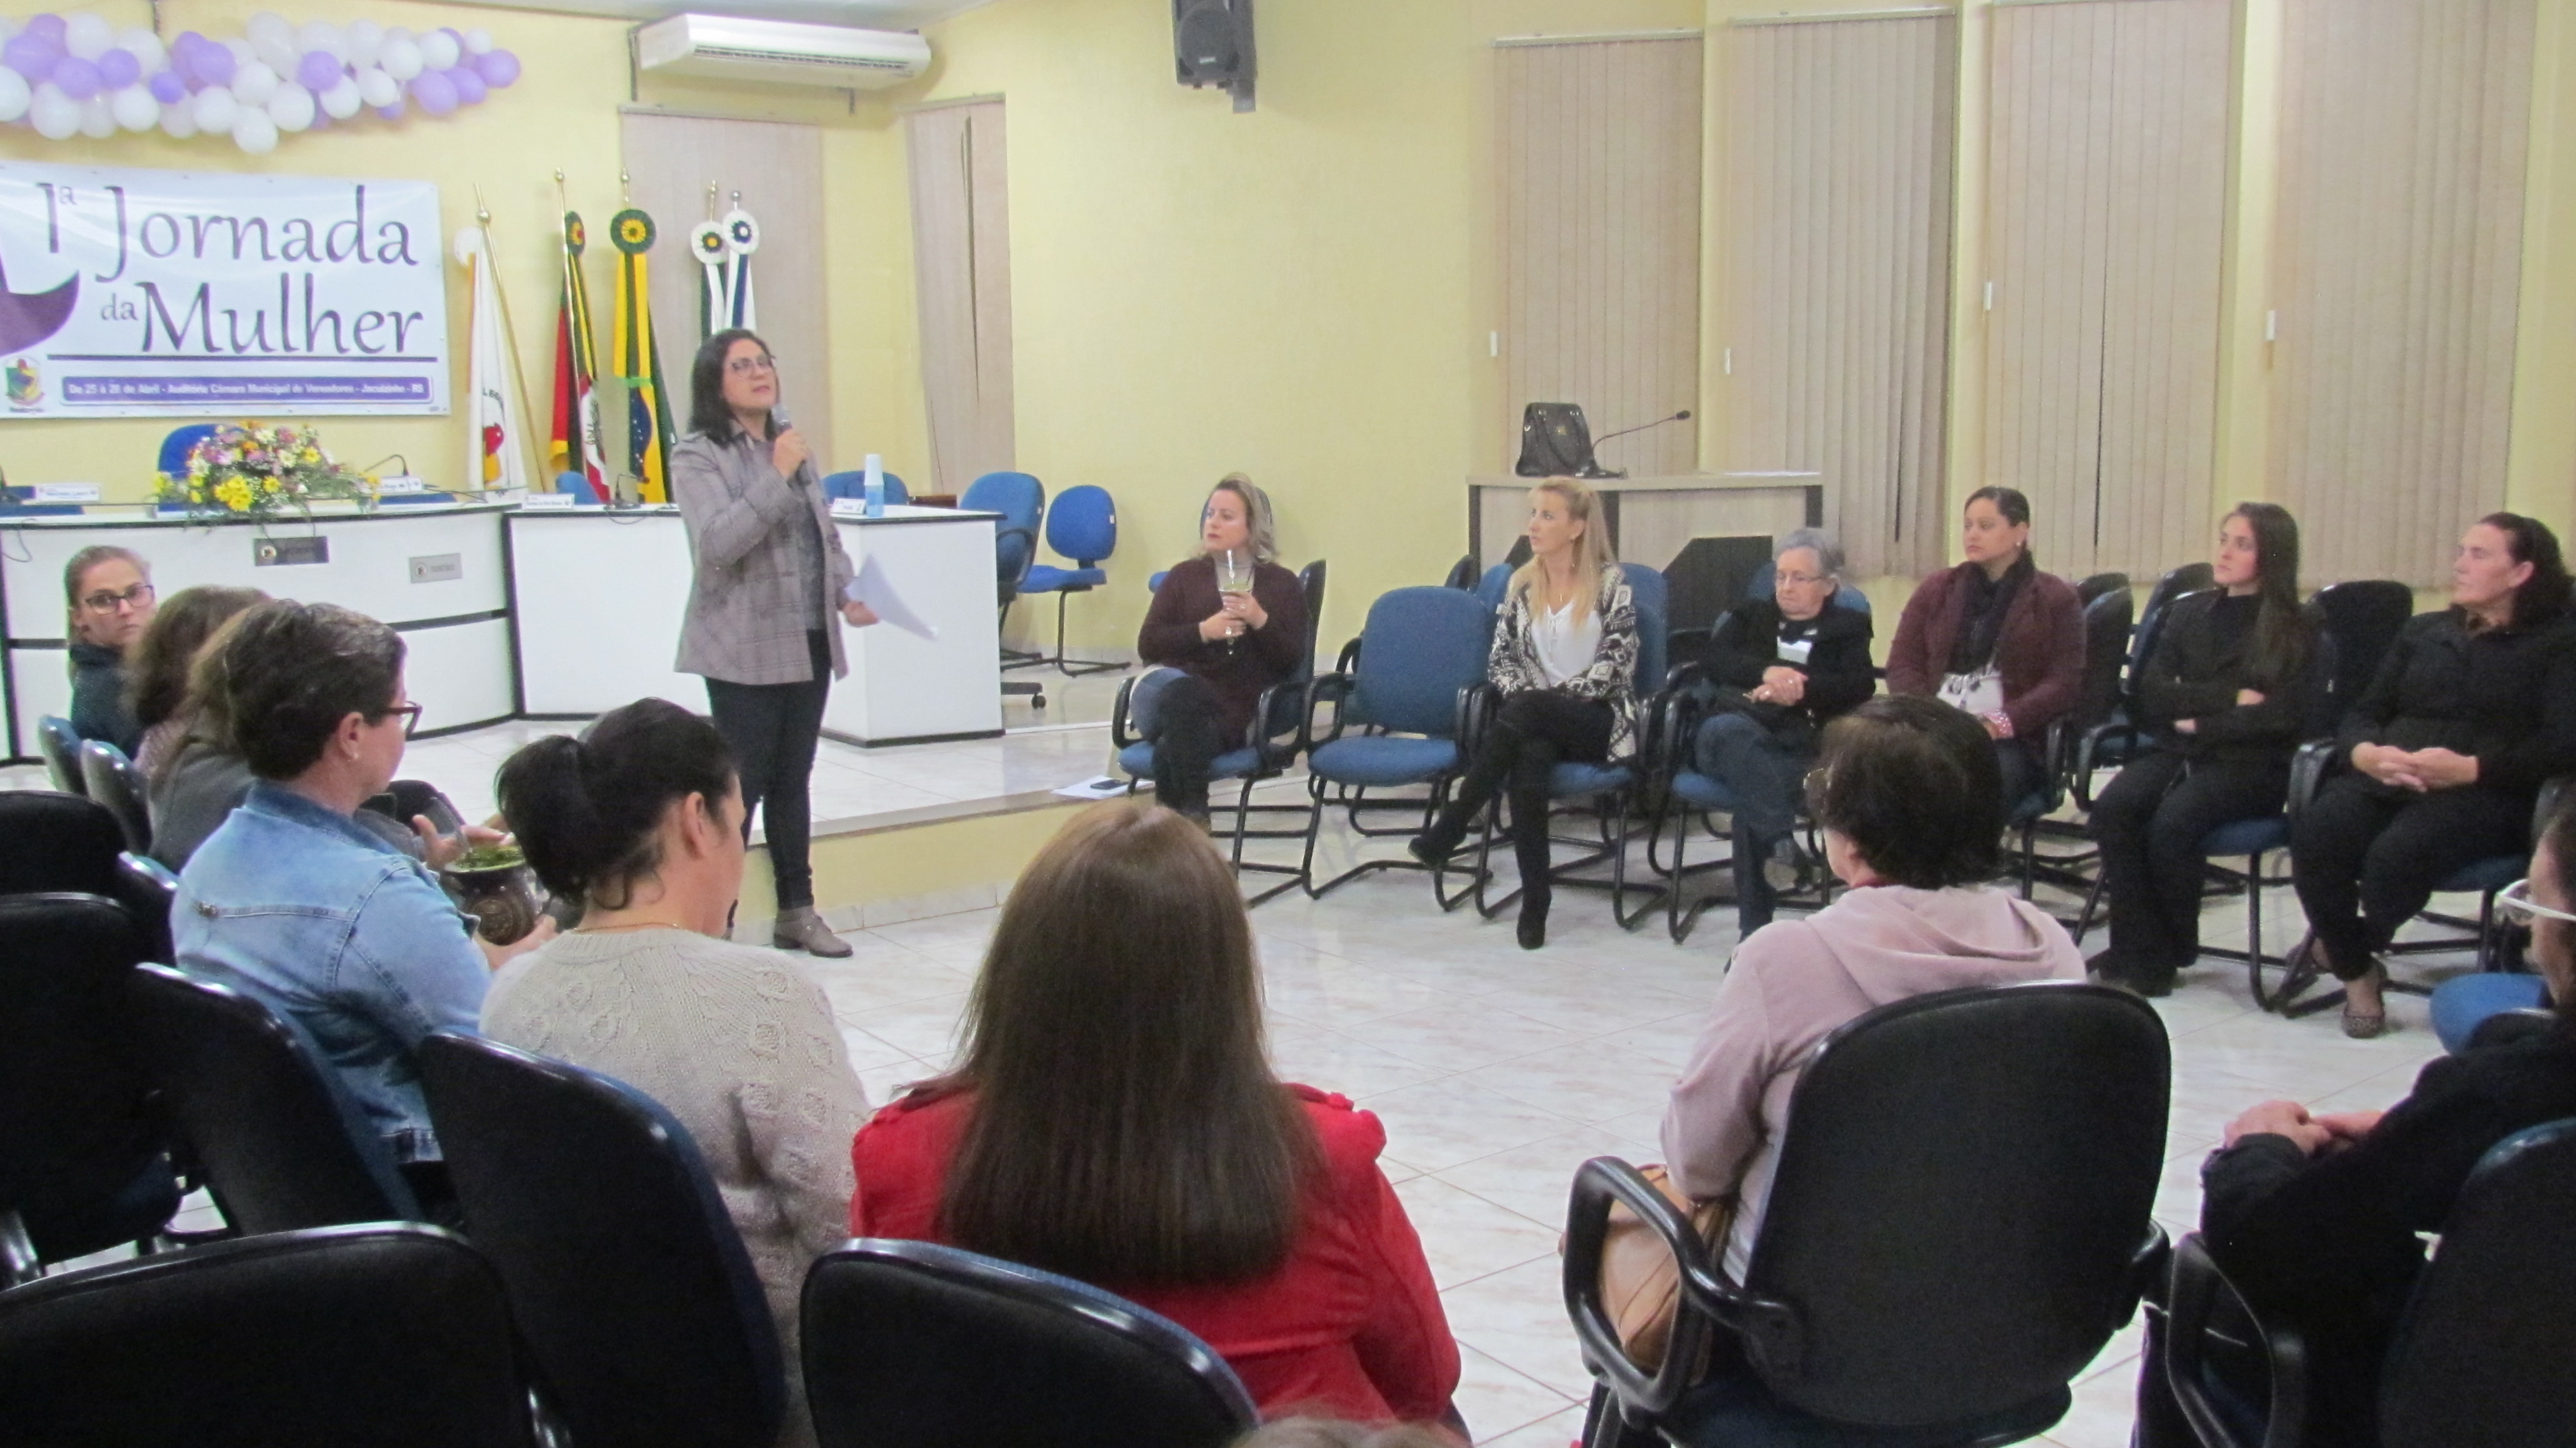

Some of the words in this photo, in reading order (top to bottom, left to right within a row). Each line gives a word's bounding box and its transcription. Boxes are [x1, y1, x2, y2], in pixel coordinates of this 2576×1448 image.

[94, 184, 419, 283] Jornada
[101, 292, 139, 320] da
[134, 273, 424, 354] Mulher
[69, 384, 83, 394] De
[122, 383, 136, 394] de
[138, 383, 160, 394] Abril
[248, 383, 291, 396] Municipal
[411, 383, 425, 394] RS
